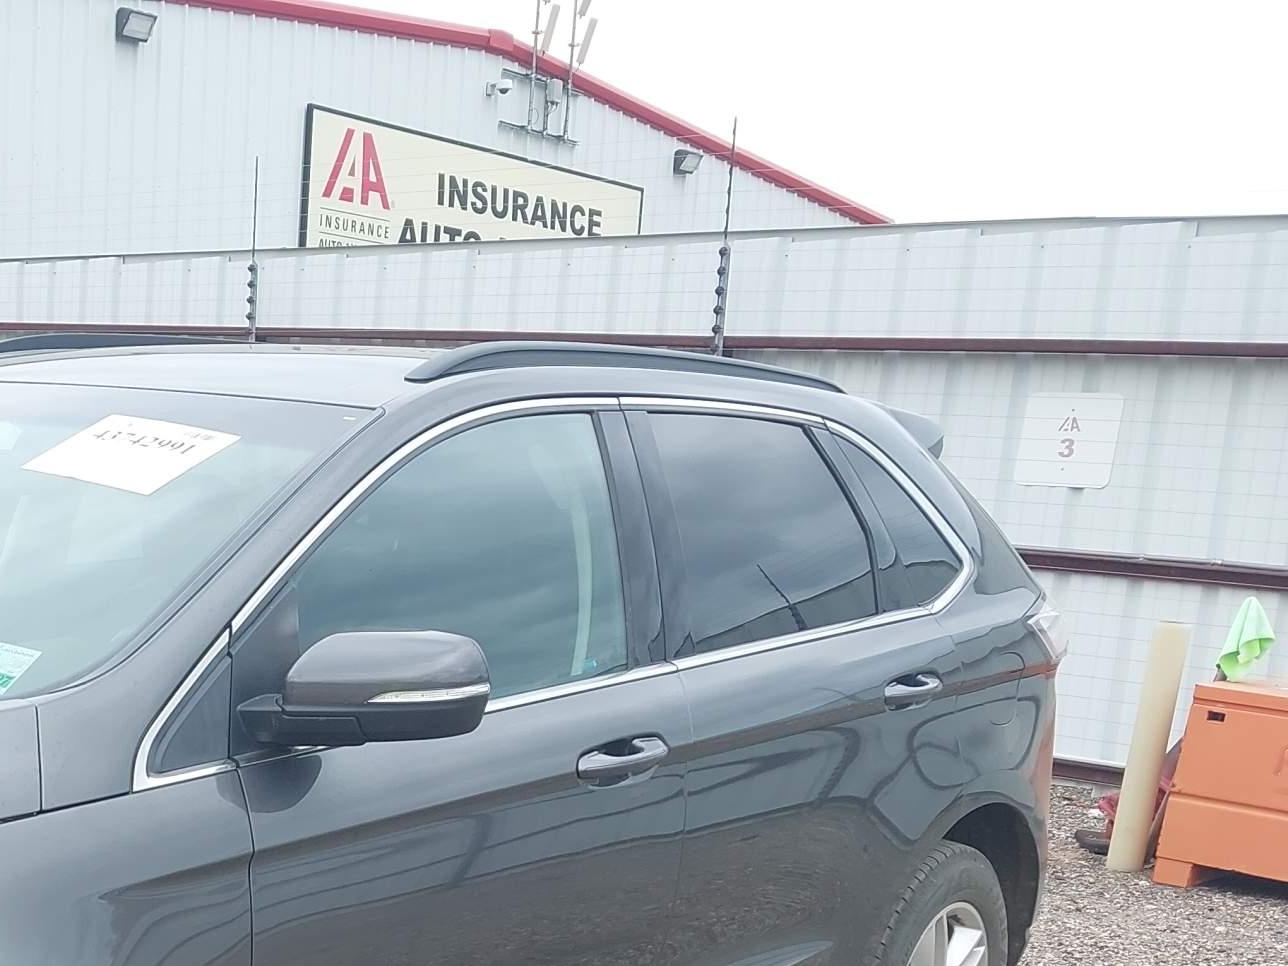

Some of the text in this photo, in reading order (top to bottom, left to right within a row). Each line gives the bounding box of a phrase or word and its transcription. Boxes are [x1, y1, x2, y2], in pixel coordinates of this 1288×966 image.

[437, 172, 602, 236] INSURANCE
[319, 213, 389, 239] INSURANCE
[398, 217, 482, 243] AUT
[1058, 438, 1075, 458] 3
